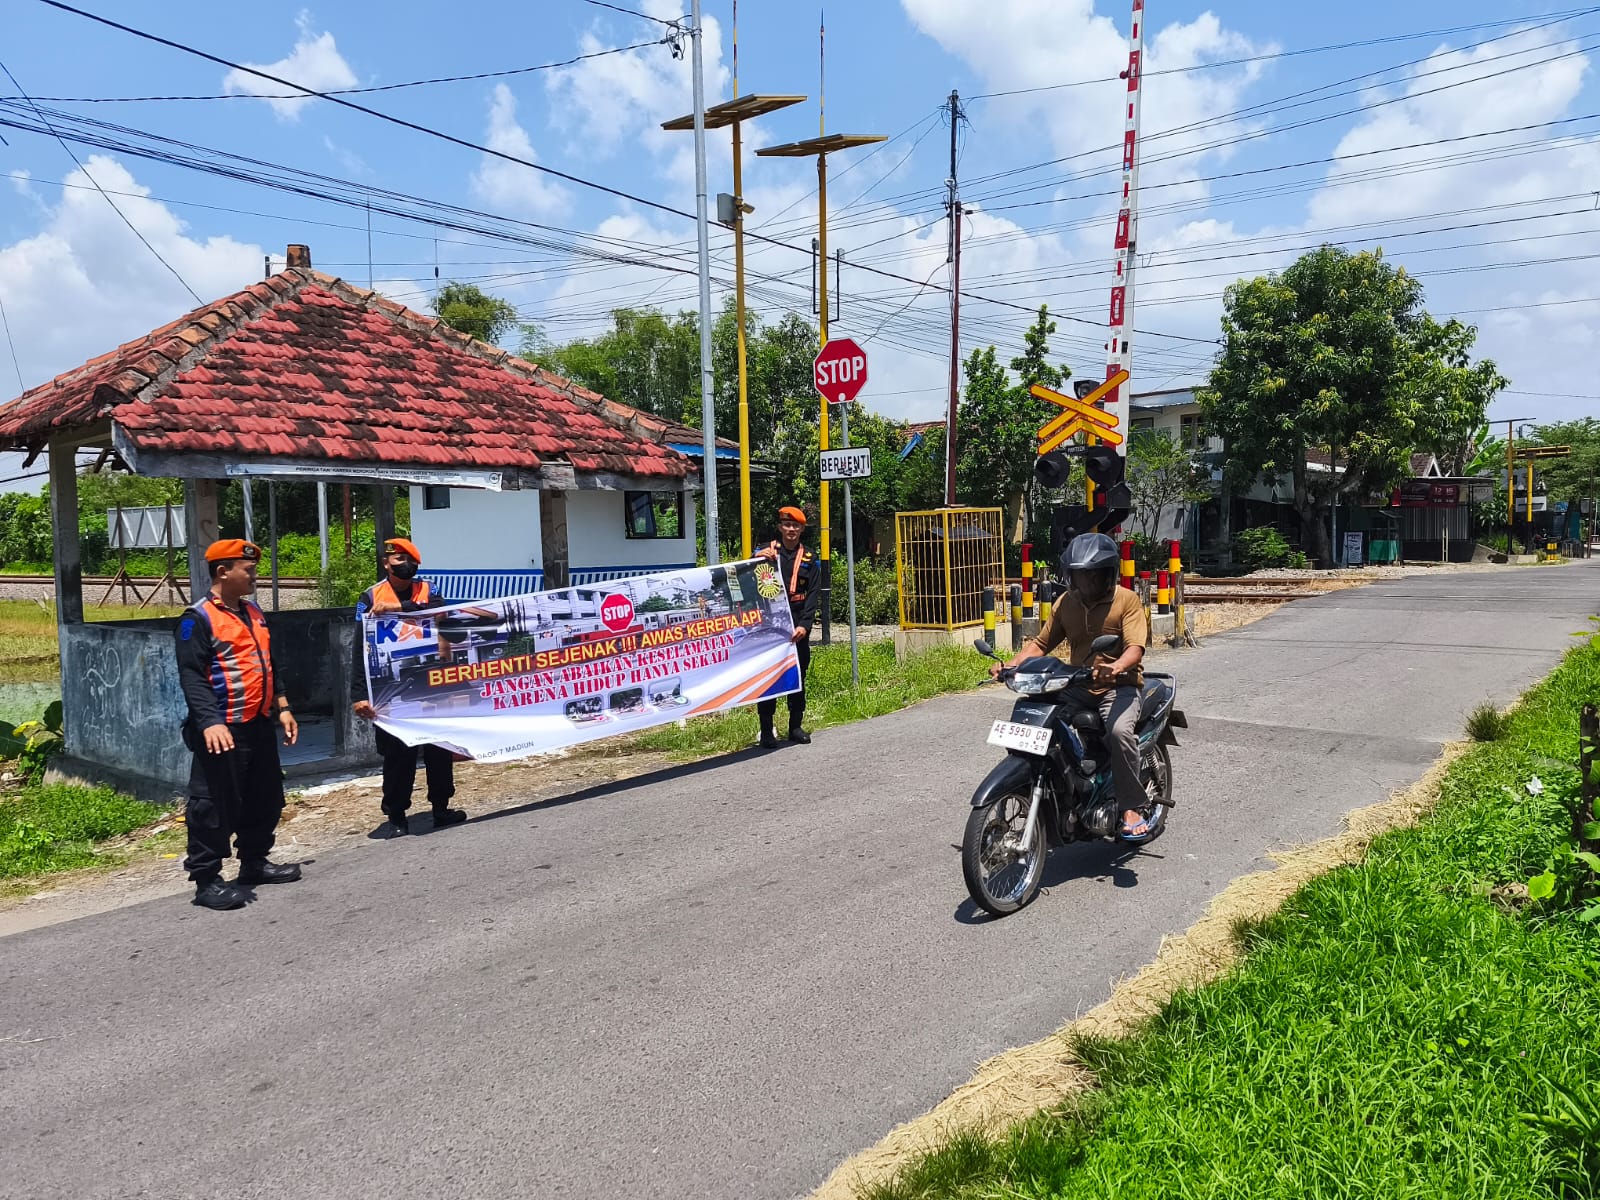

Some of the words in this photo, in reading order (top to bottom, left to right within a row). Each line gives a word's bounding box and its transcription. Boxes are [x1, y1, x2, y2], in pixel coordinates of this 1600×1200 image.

[817, 355, 864, 386] STOP
[820, 454, 870, 473] BERHENTI
[603, 603, 631, 622] STOP
[376, 618, 432, 645] KAI
[429, 656, 531, 686] BERHENTI
[536, 639, 618, 668] SEJENAK
[621, 636, 637, 651] !!!
[641, 627, 684, 648] AWAS
[686, 614, 739, 637] KERETA
[741, 609, 762, 626] API
[480, 672, 554, 697] JANGAN
[559, 655, 633, 682] ABAIKAN
[637, 634, 735, 667] KESELAMATAN
[493, 685, 568, 710] KARENA
[573, 673, 626, 696] HIDUP
[630, 662, 680, 683] HANYA
[684, 650, 729, 671] SEKALI
[994, 723, 1007, 734] AE
[1008, 725, 1032, 738] 5950
[505, 740, 535, 753] MADIUN
